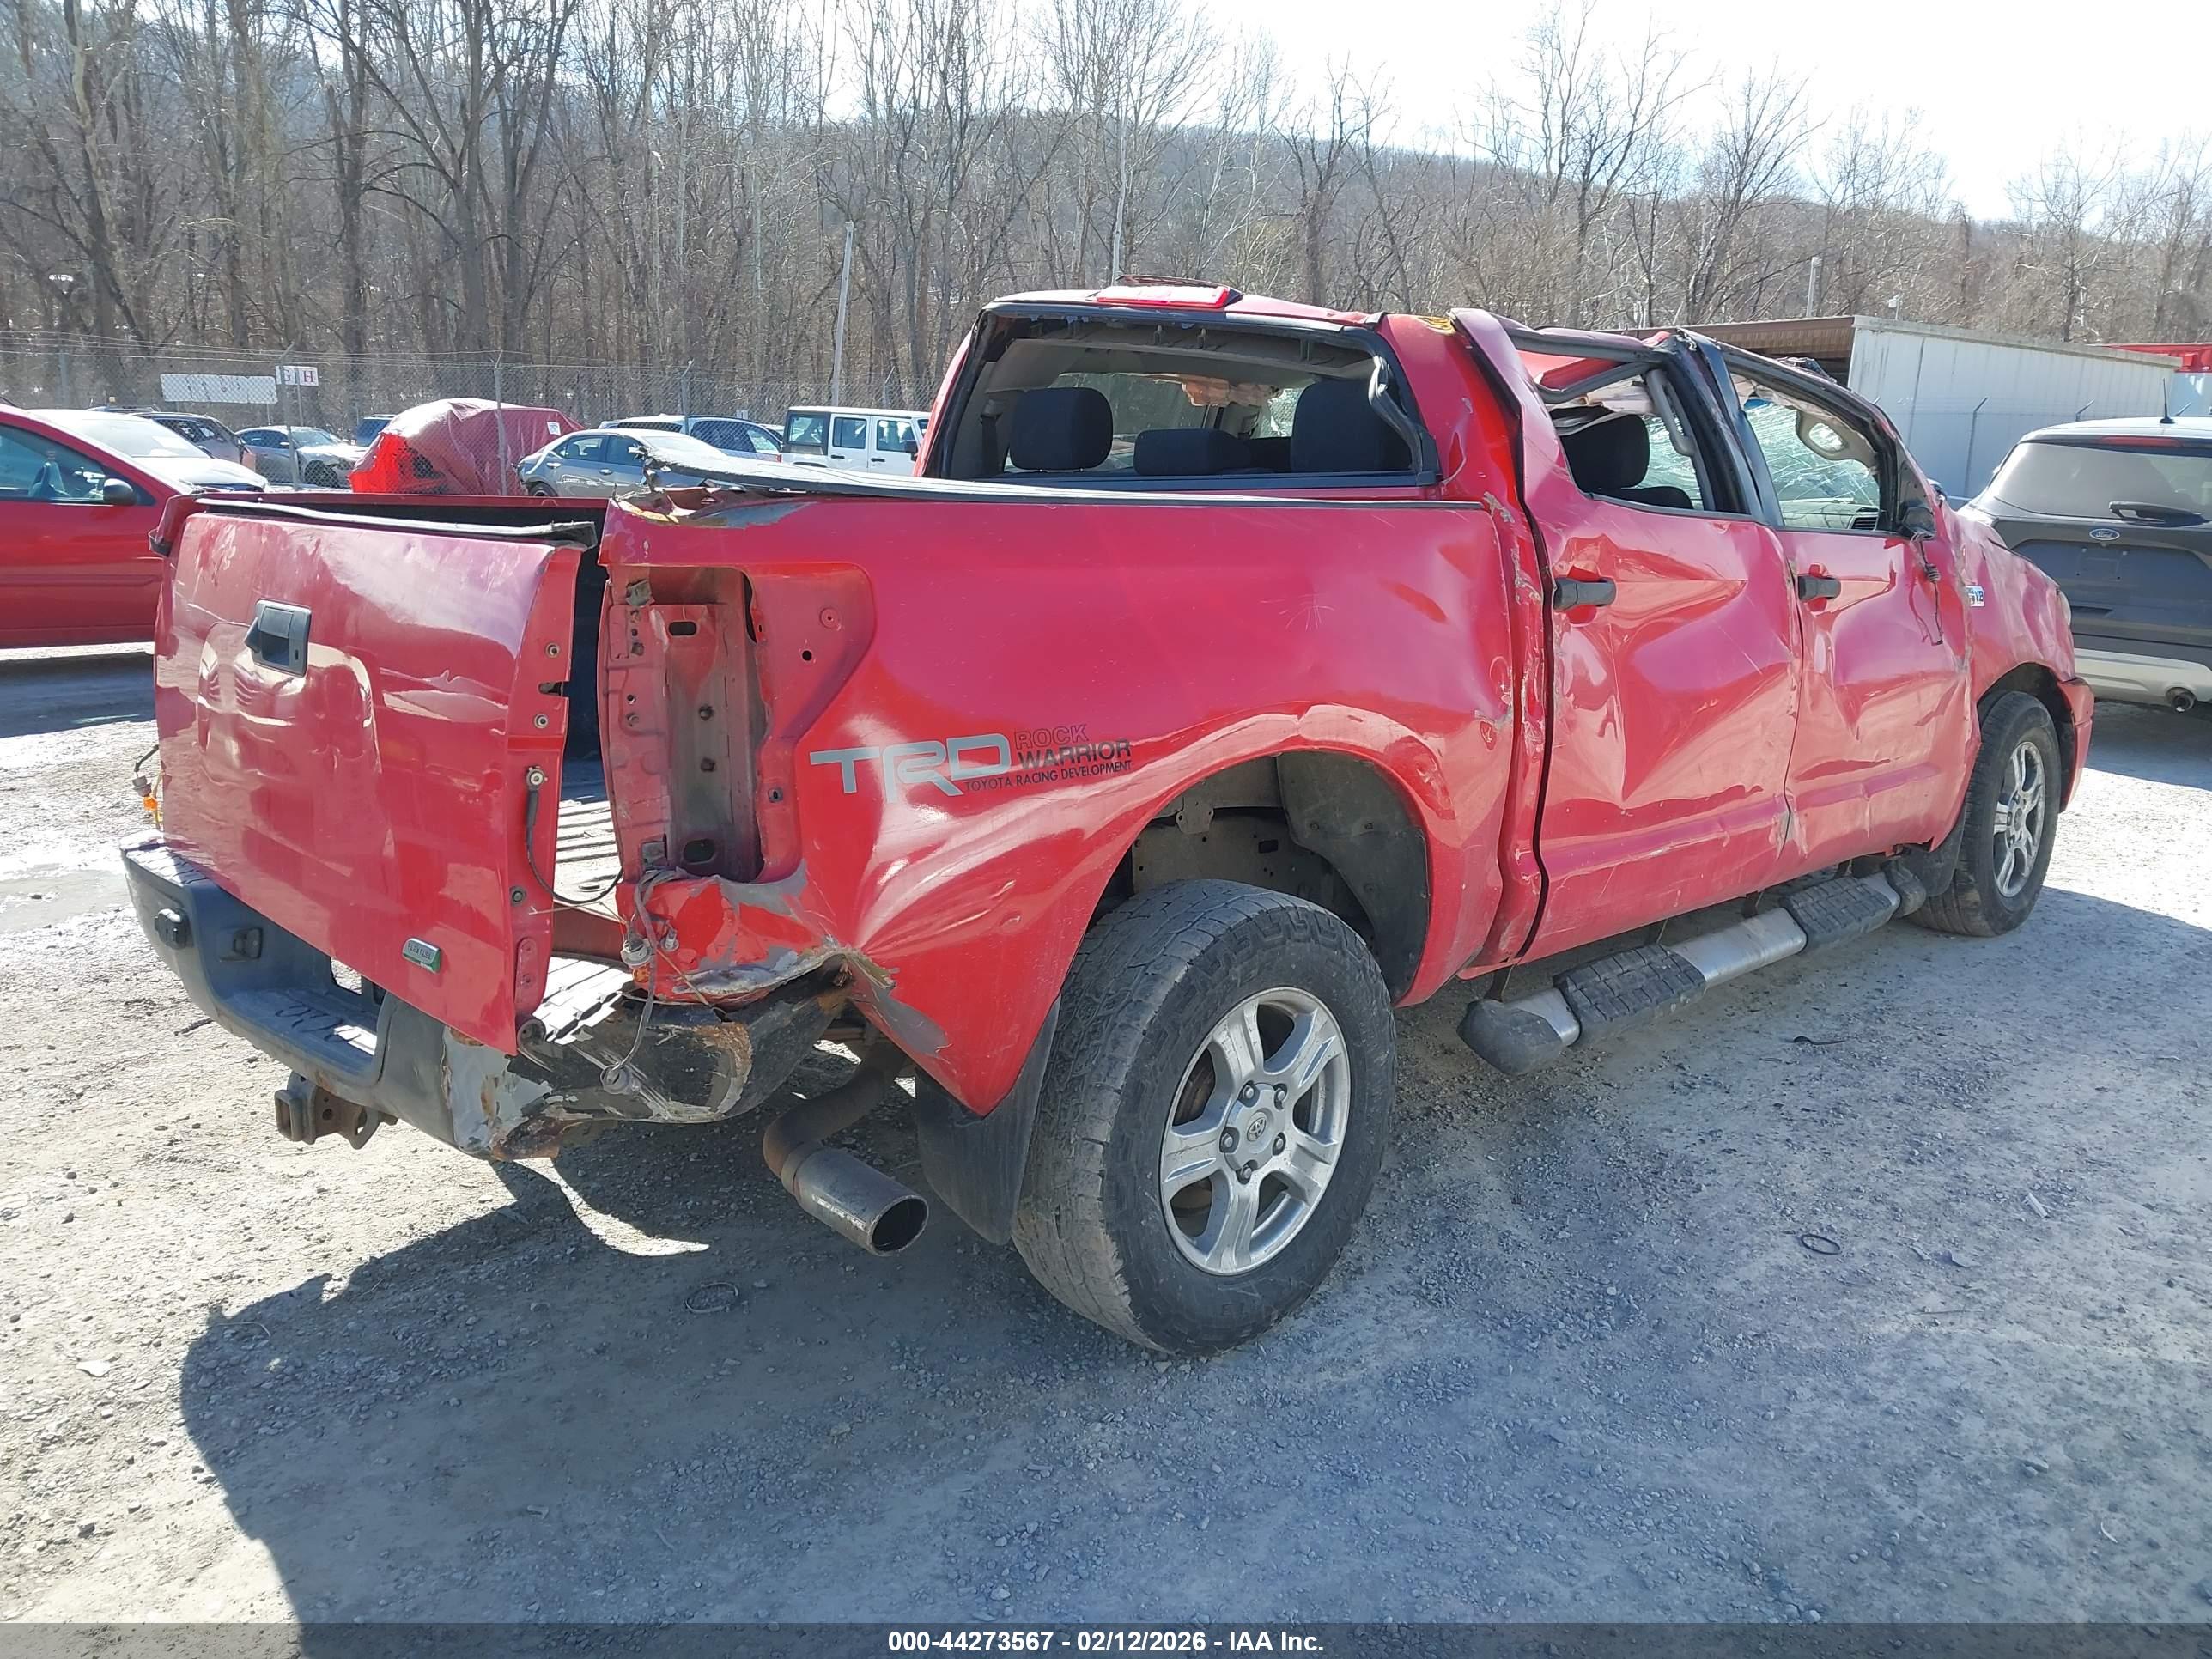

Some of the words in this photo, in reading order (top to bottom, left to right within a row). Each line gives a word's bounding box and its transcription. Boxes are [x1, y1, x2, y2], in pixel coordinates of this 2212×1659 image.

[303, 370, 313, 383] H
[1014, 724, 1089, 750] ROCK
[810, 733, 1012, 804] TRD
[1018, 738, 1131, 770] WARRIOR
[964, 778, 1015, 792] TOYOTA
[1017, 769, 1059, 787] RACING
[1061, 762, 1132, 780] DEVELOPMENT
